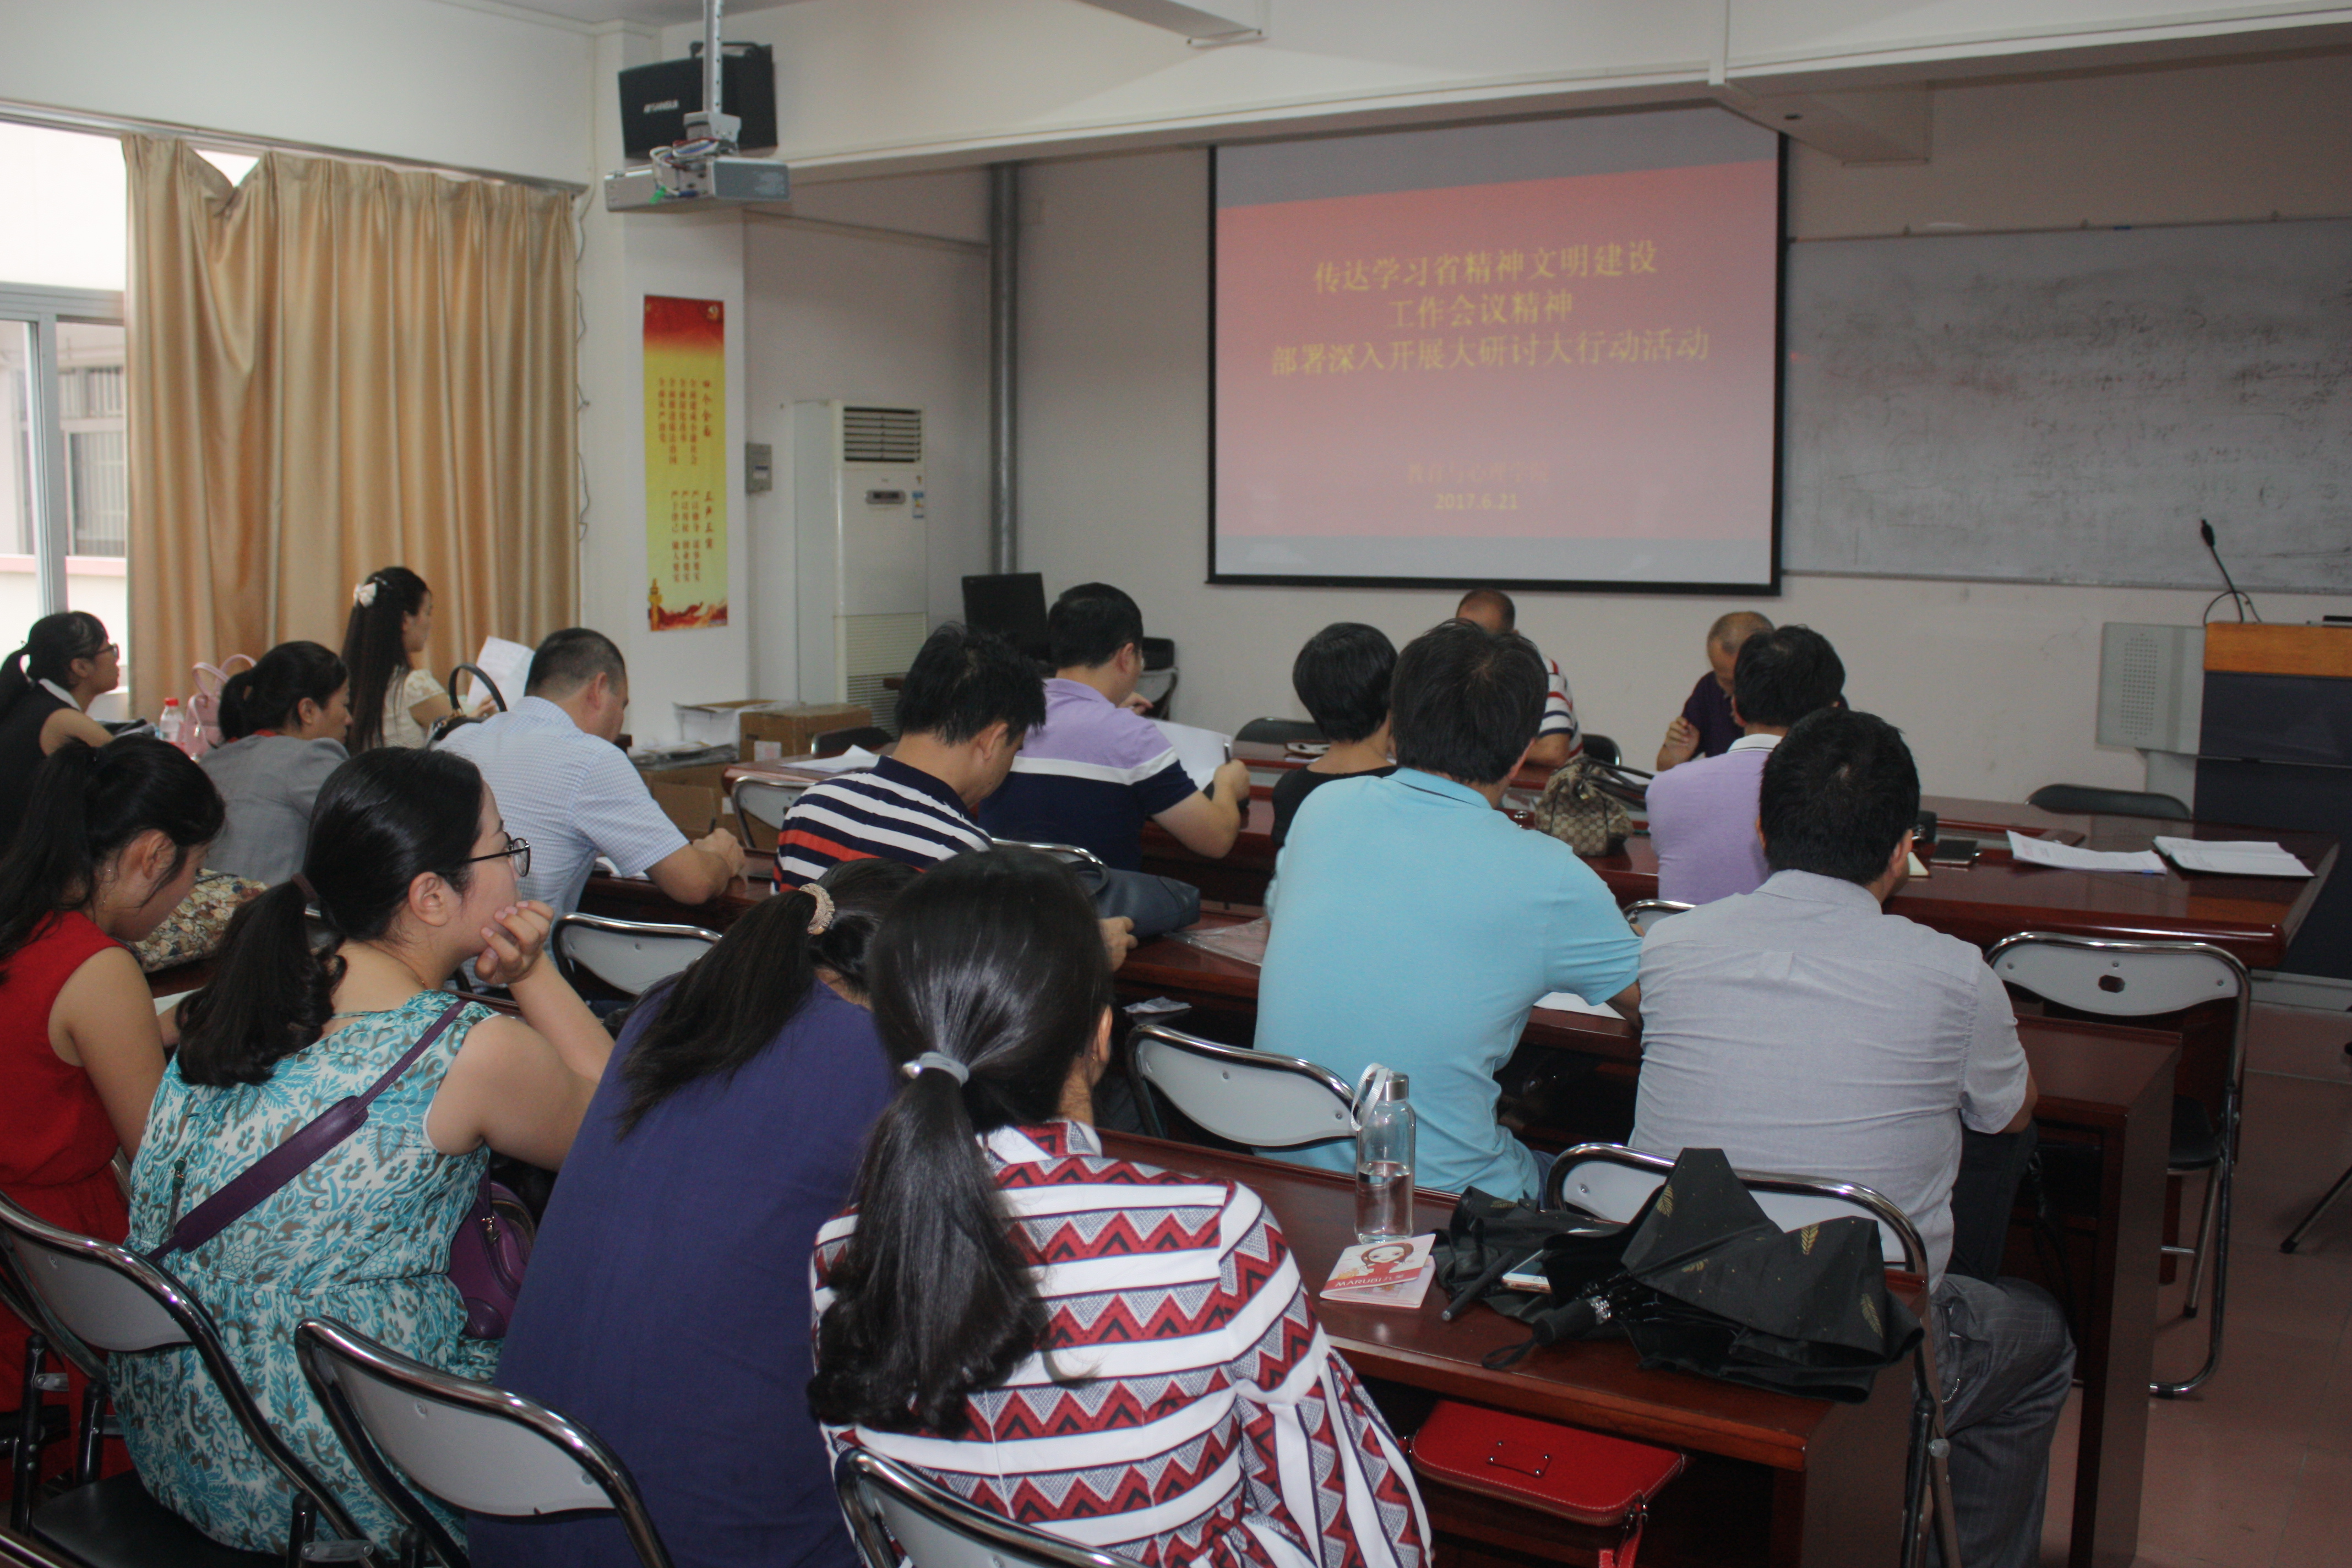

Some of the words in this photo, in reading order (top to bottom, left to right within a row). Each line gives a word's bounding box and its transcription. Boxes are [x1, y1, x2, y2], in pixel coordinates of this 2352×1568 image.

[1315, 240, 1657, 293] 传达学习省精神文明建设
[1387, 288, 1572, 329] 工作会议精神
[1272, 328, 1708, 376] 部署深入开展大研讨大行动活动
[1434, 493, 1518, 509] 2017.6.21
[1335, 1277, 1382, 1287] MARUBI
